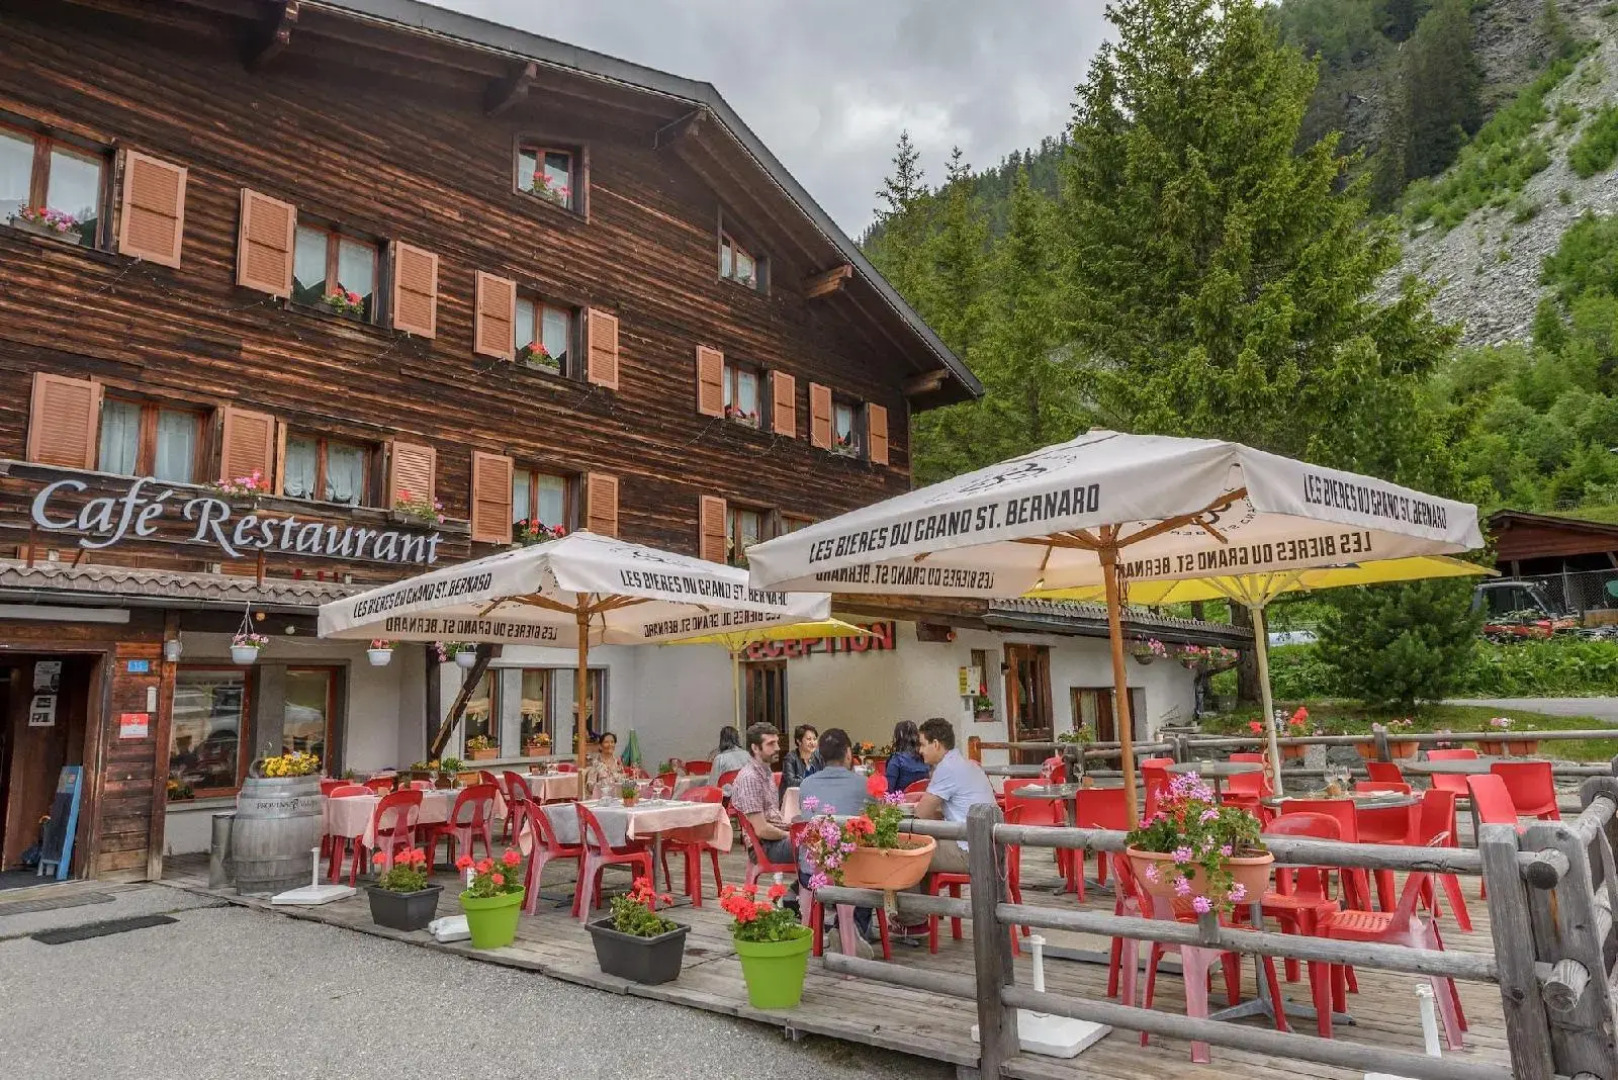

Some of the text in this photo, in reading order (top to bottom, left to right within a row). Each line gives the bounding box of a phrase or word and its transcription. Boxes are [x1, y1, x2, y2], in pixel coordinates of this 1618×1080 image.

[31, 476, 444, 564] Café Restaurant
[808, 483, 1101, 564] LES BIERES DU GRAND ST. BERNARD
[1303, 473, 1322, 504] LES
[1323, 478, 1357, 512] BIERES
[1357, 486, 1370, 514] DU
[1370, 488, 1400, 520] GRAND
[1413, 499, 1447, 529] BERNARD
[353, 602, 367, 619] LES
[367, 595, 395, 615] BIERES
[394, 589, 406, 606] DU
[405, 582, 436, 605] GRAND
[620, 569, 642, 588] LES
[643, 572, 682, 593] BIERES
[683, 577, 697, 594] DU
[699, 579, 731, 600] GRAND
[730, 621, 897, 659] ECEPTION
